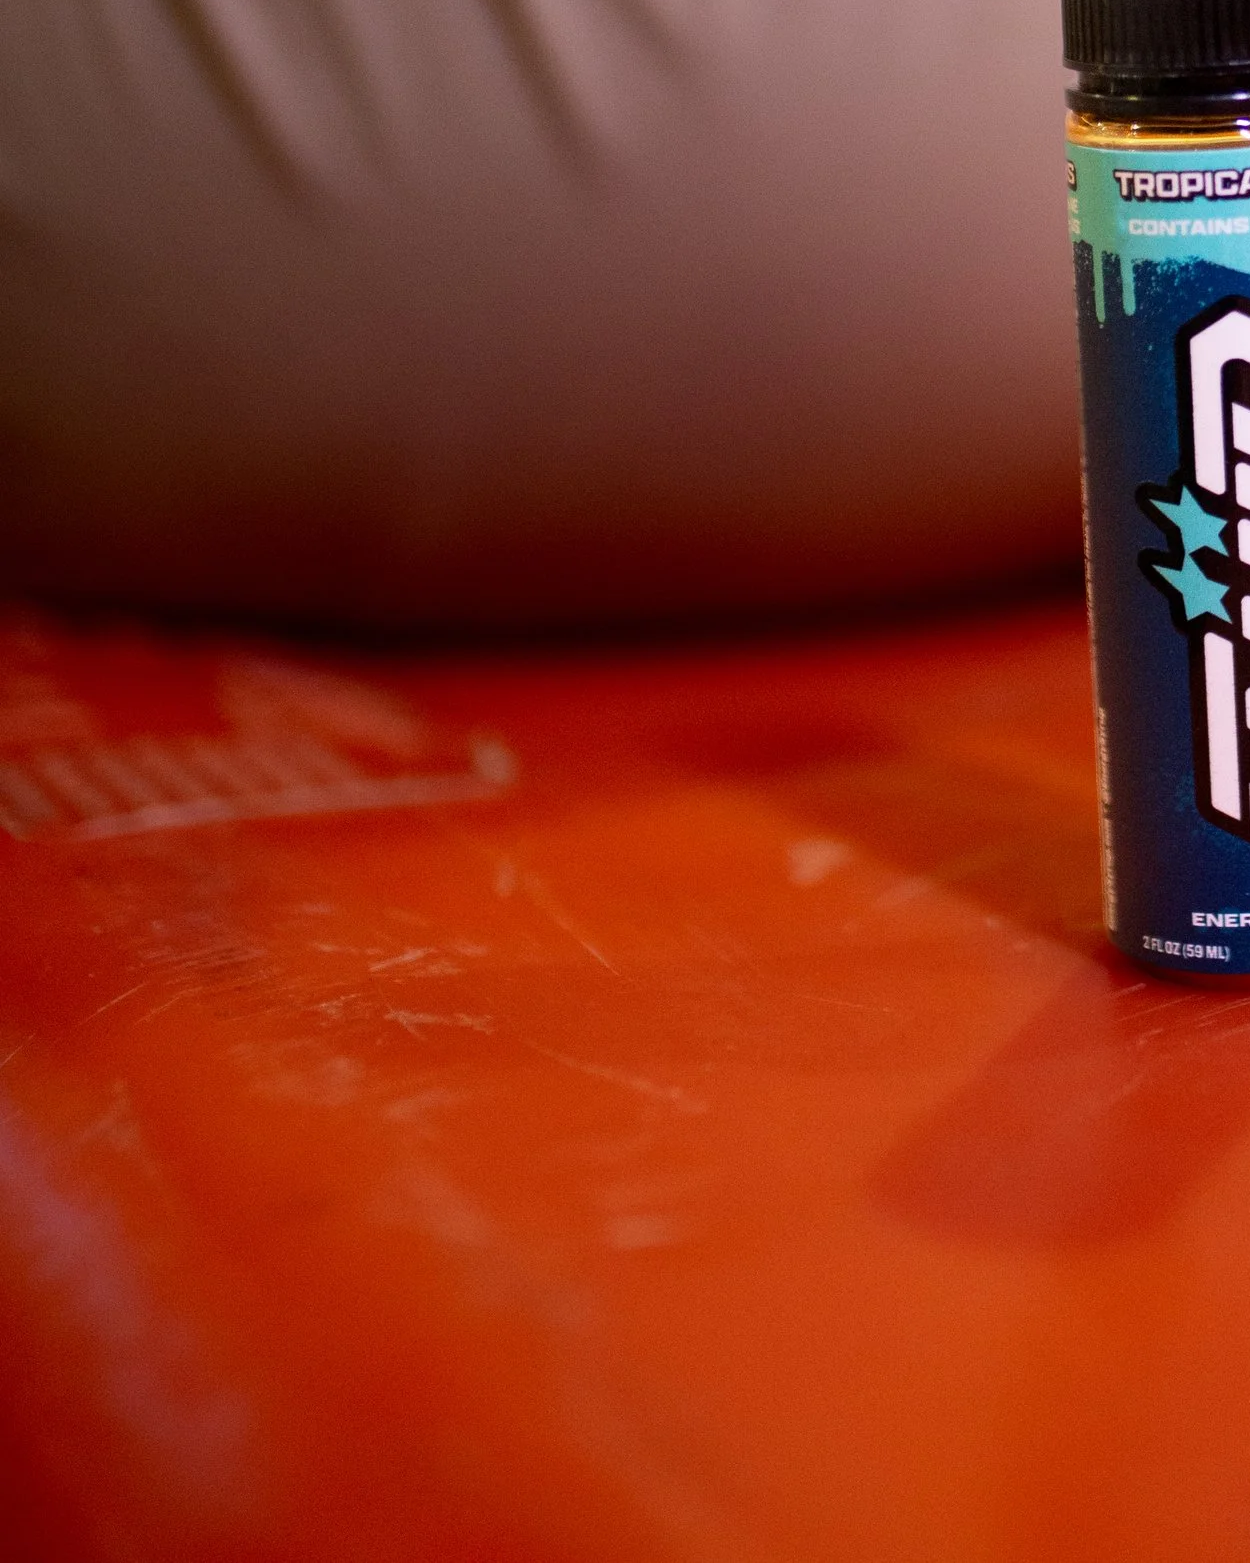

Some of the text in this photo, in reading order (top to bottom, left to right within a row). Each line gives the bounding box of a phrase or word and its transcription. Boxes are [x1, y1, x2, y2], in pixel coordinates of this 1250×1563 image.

[1128, 216, 1250, 237] CONTAINS
[1143, 935, 1231, 962] 2 FL OZ (59 ML)
